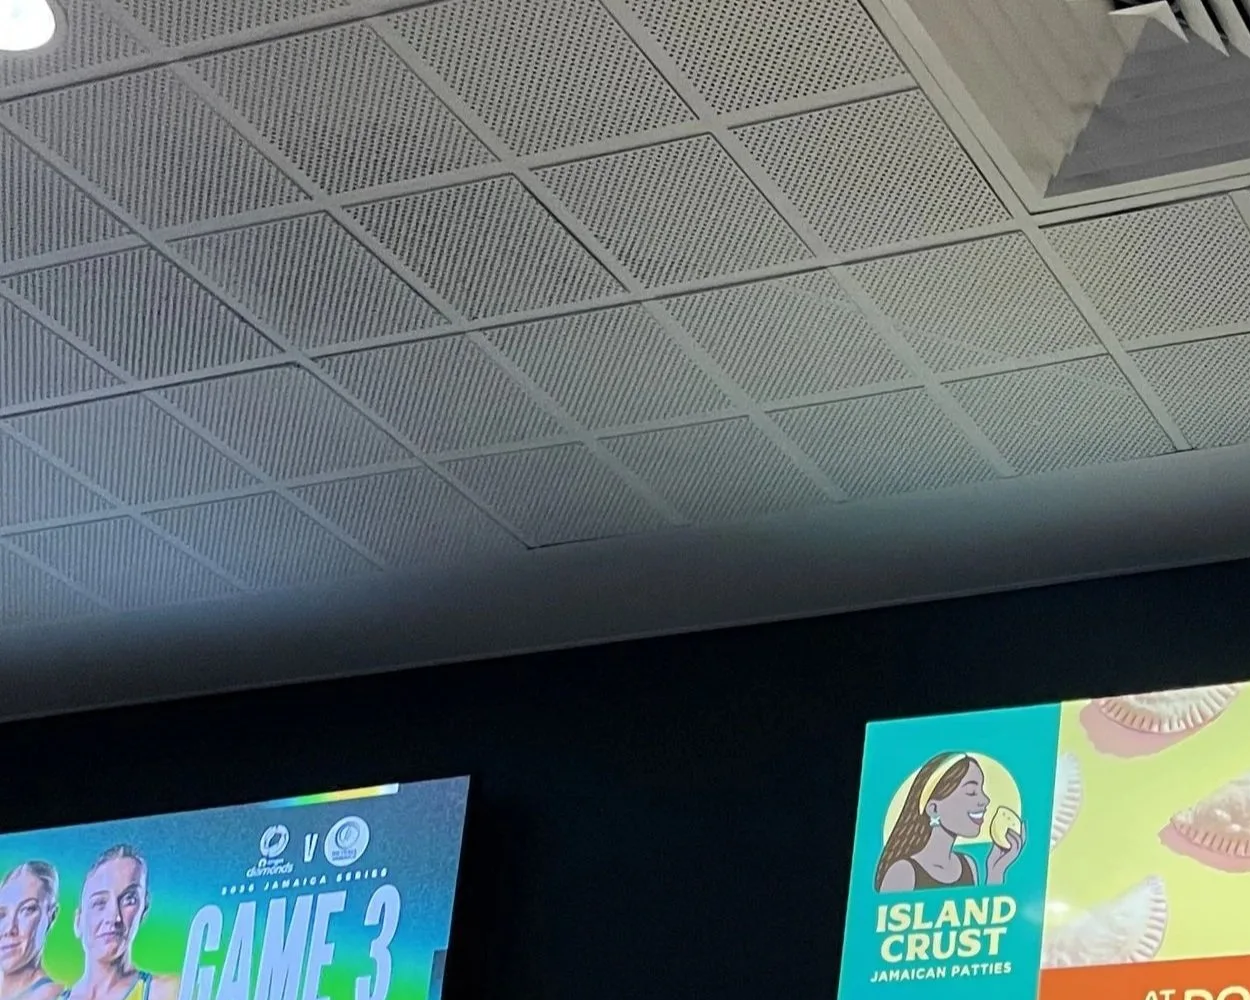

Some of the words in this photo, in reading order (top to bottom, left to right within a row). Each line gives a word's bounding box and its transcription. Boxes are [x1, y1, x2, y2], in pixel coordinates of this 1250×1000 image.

[303, 832, 319, 864] V
[263, 875, 328, 892] JAMAICA
[335, 867, 389, 883] SERIES
[875, 894, 1018, 934] ISLAND
[878, 925, 1008, 964] CRUST
[869, 964, 947, 984] JAMAICAN
[950, 960, 1013, 980] PATTIES
